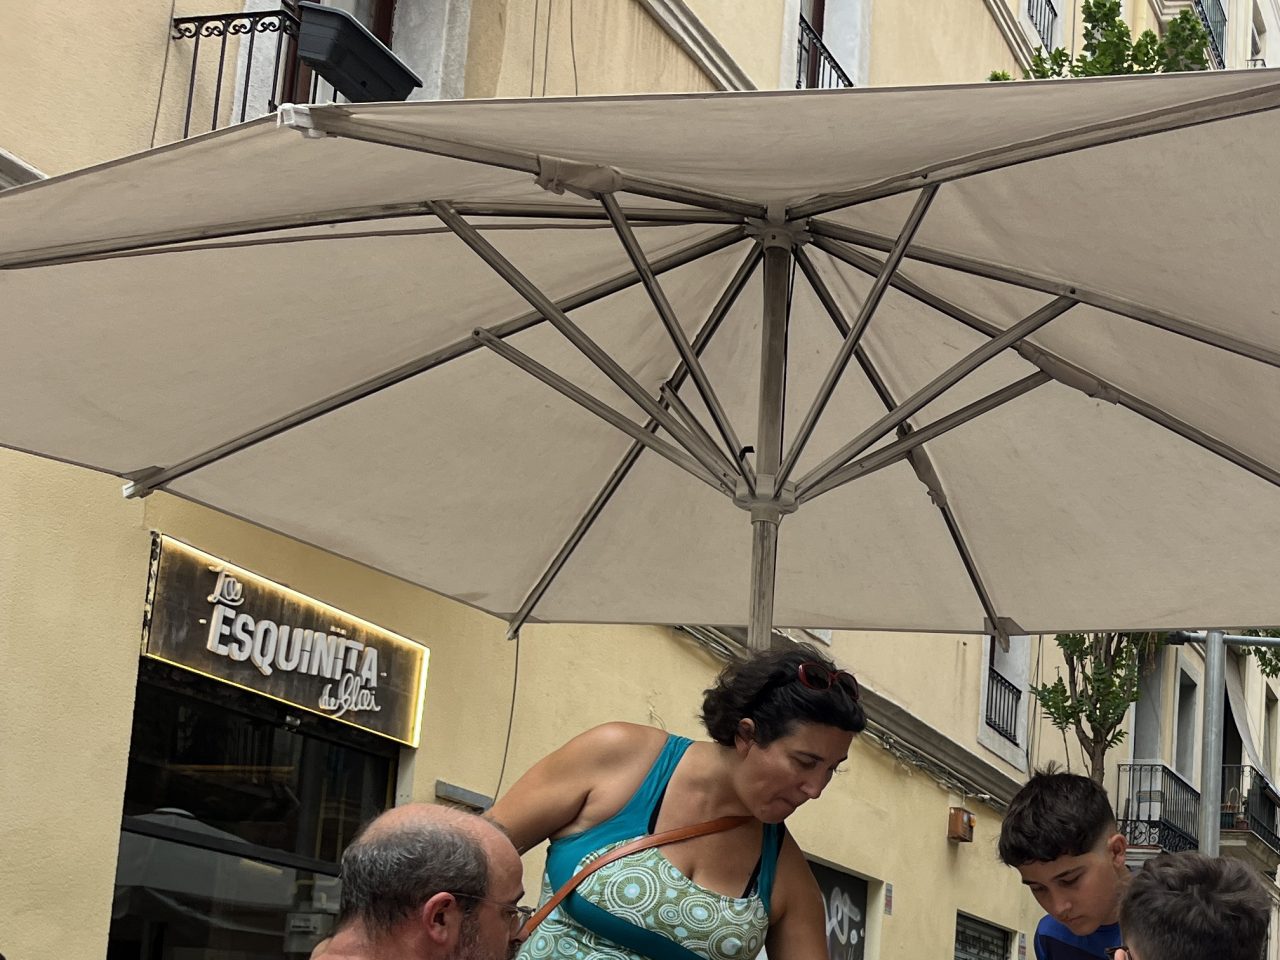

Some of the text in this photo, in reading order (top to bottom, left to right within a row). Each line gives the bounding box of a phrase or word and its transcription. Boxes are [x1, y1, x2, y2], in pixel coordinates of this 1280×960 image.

[207, 565, 245, 606] La
[207, 604, 379, 688] ESQUINITA
[318, 684, 341, 711] de
